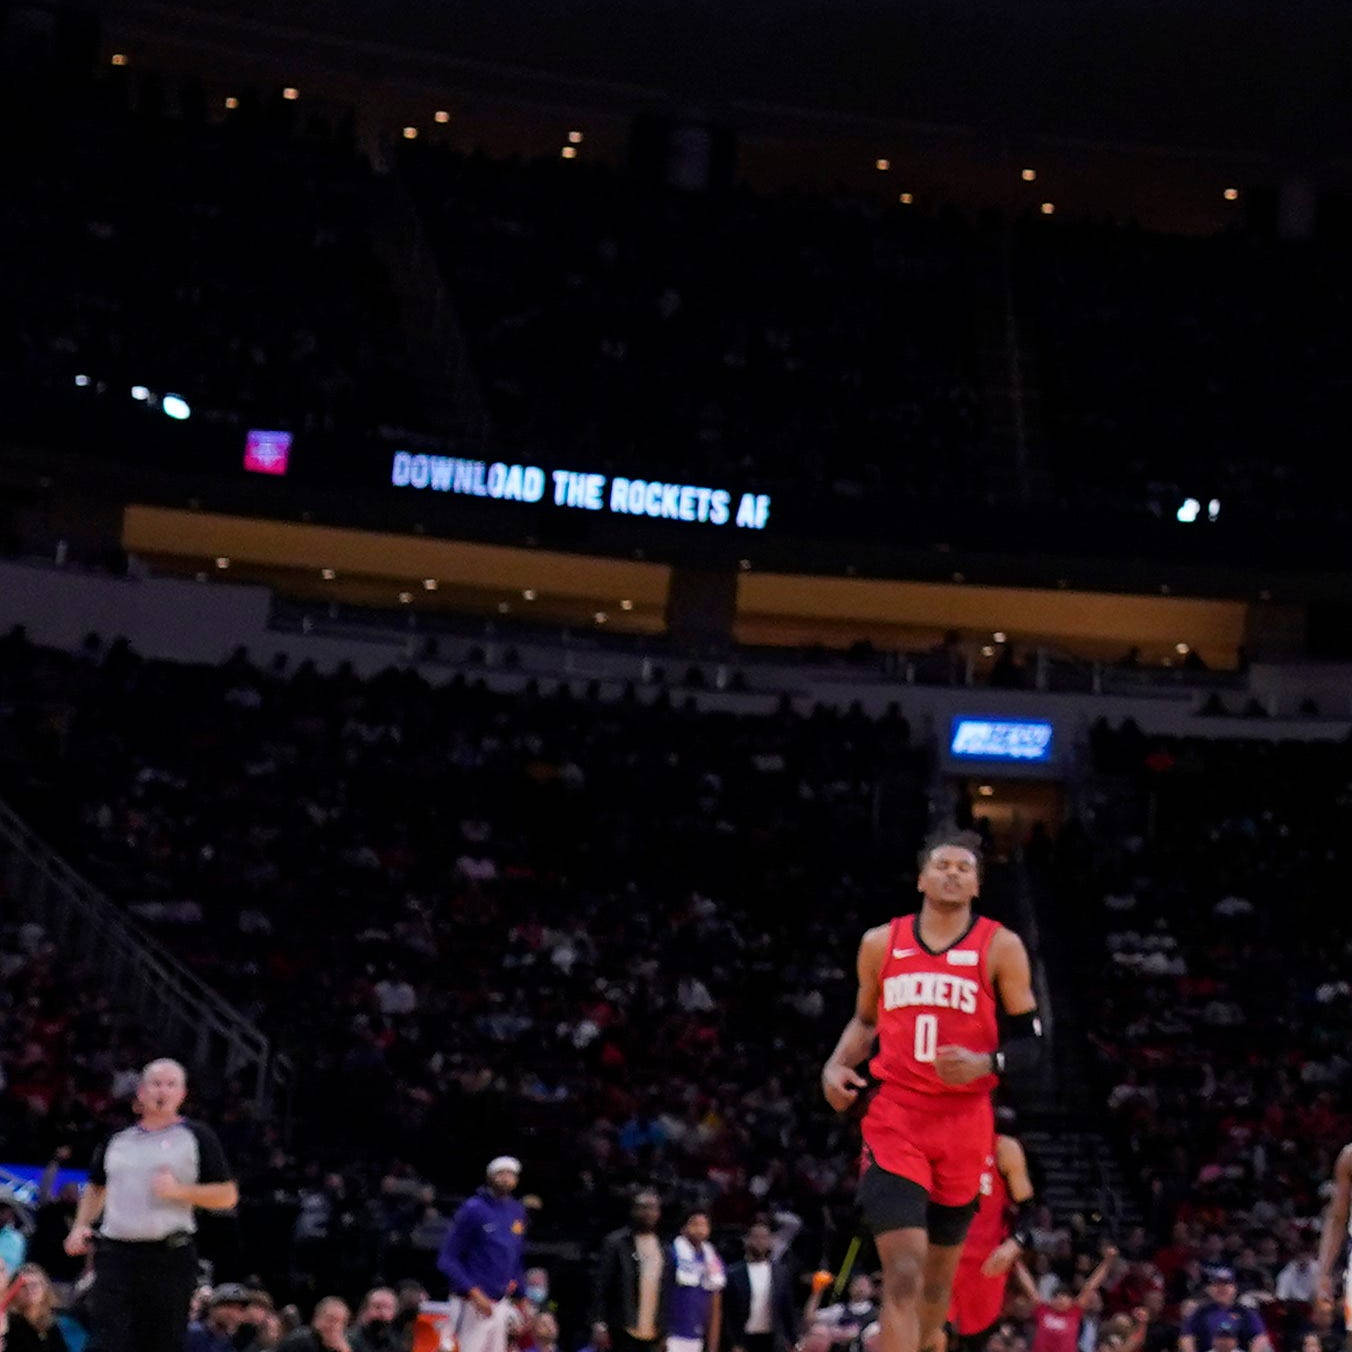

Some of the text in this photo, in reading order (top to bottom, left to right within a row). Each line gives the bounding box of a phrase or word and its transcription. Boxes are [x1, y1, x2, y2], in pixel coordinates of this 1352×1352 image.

[392, 450, 546, 503] DOWNLOAD
[552, 469, 605, 511] THE
[610, 477, 731, 525] ROCKETS
[883, 972, 980, 1015] ROCKETS
[914, 1014, 938, 1063] 0
